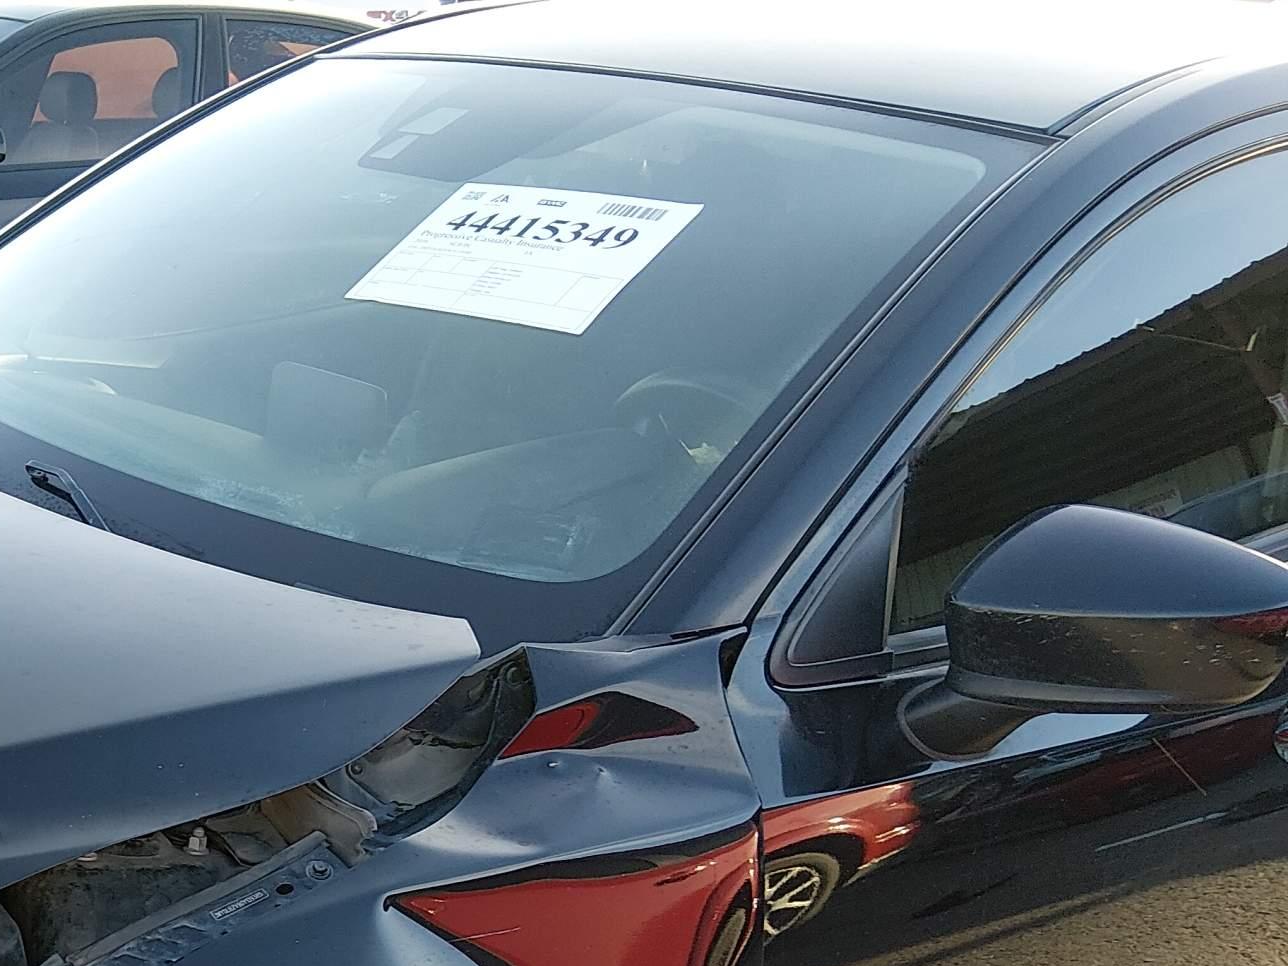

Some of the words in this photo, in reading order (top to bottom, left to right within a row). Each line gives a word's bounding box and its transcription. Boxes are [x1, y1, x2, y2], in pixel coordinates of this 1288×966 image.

[420, 229, 473, 242] Progressive
[474, 234, 516, 247] Casualty
[518, 238, 565, 253] Insurance
[446, 210, 640, 250] 44415349
